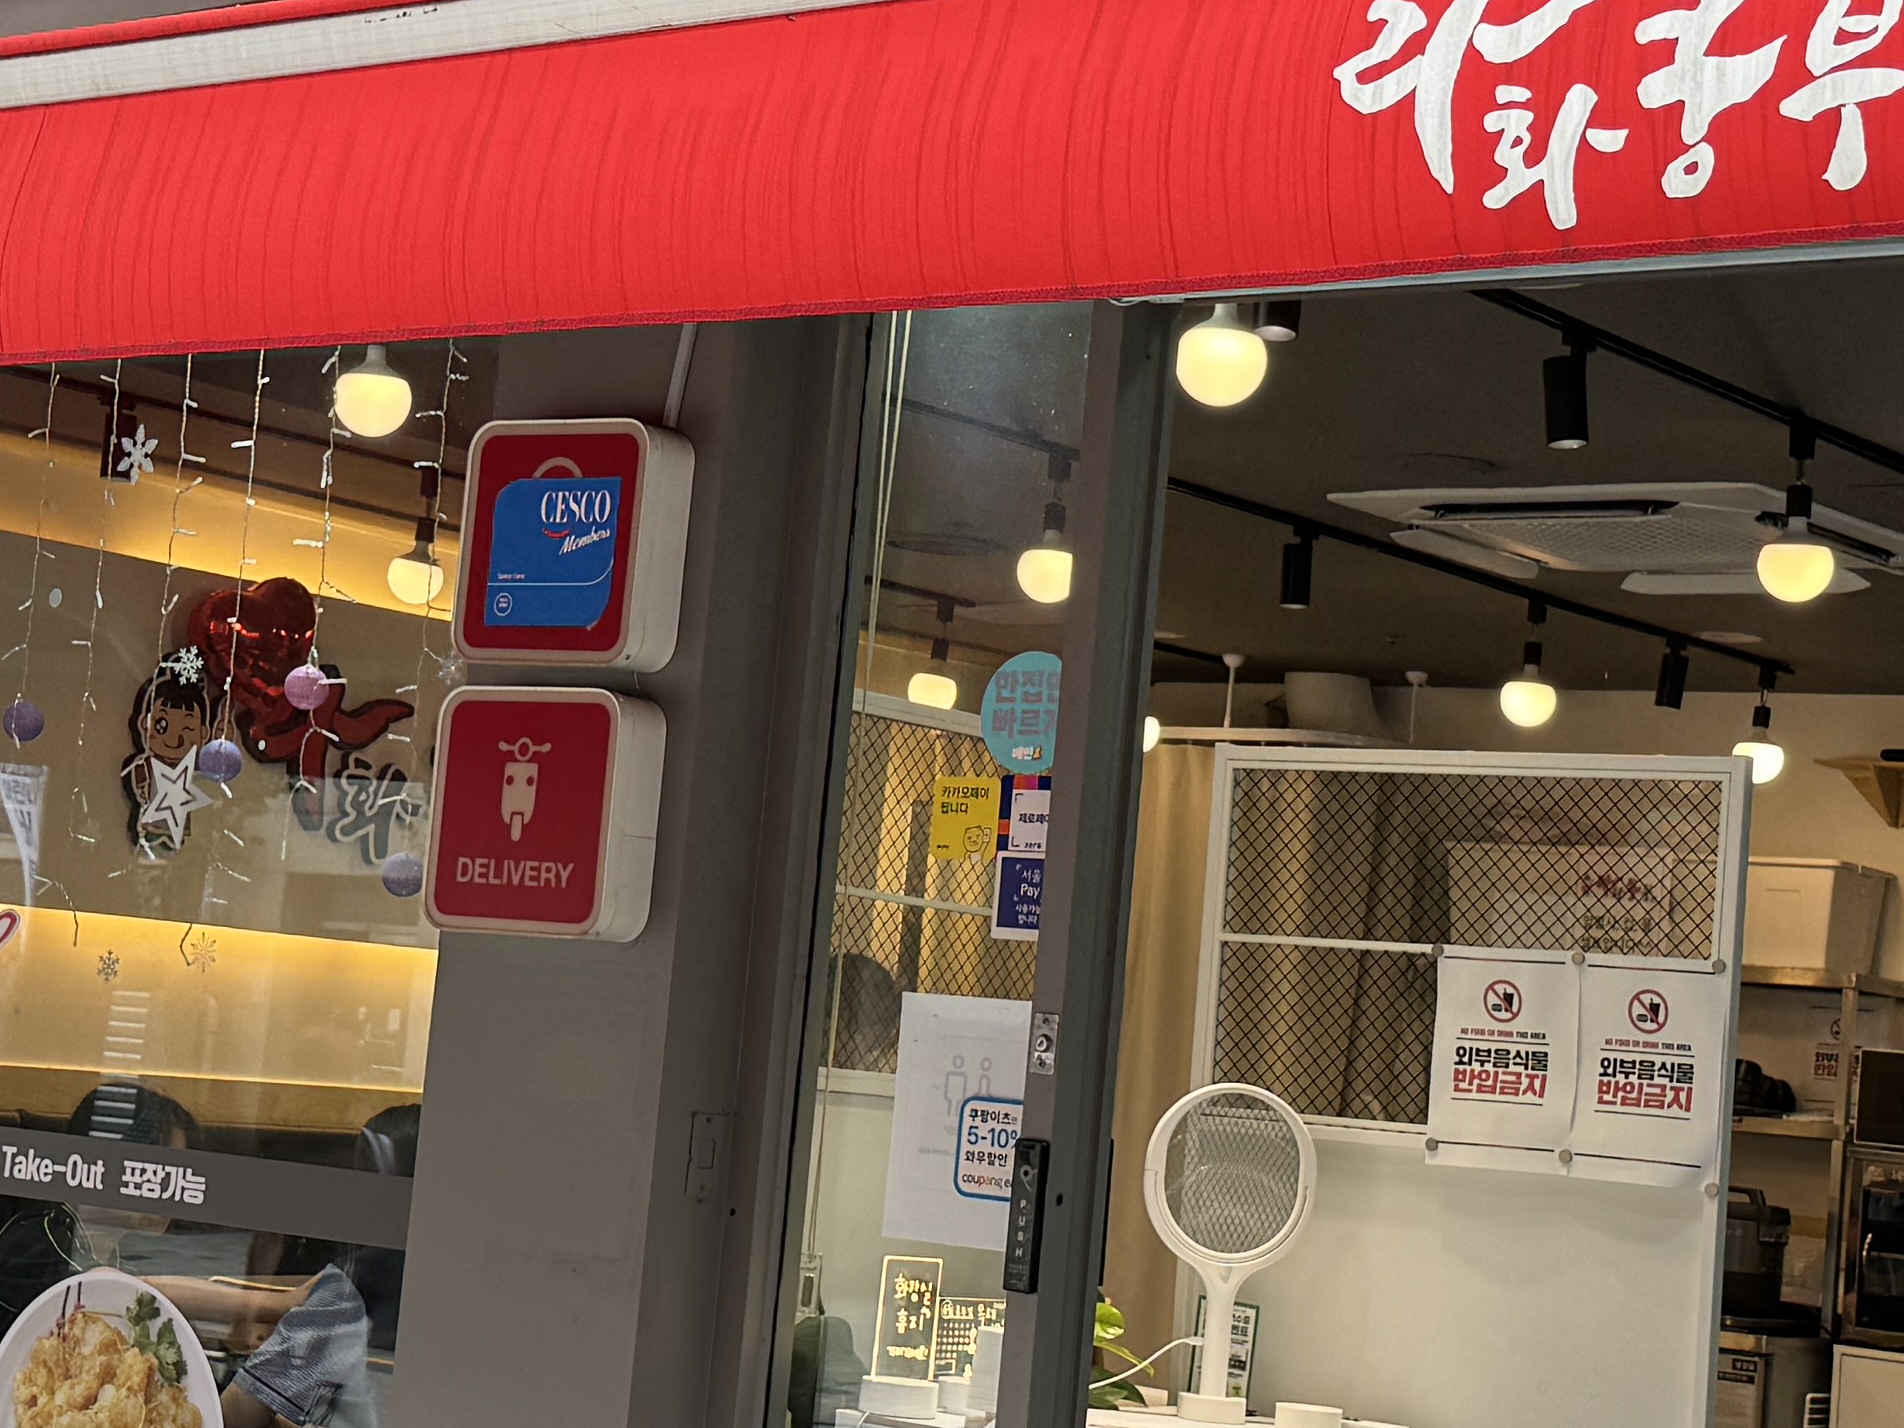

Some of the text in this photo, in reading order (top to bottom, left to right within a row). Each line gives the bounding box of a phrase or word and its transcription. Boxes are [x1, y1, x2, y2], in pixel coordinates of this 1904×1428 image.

[540, 490, 612, 525] CESCO
[558, 527, 611, 556] Members
[940, 785, 990, 800] 카카오페이
[456, 856, 574, 888] DELIVERY
[1021, 884, 1040, 899] Pay
[1454, 1046, 1549, 1072] 외부음식물
[1600, 1057, 1695, 1084] 외부음식물
[1453, 1069, 1548, 1099] 반입금지
[1597, 1080, 1693, 1113] 반입금지
[964, 1150, 1008, 1167] 와우할인
[2, 1145, 105, 1191] Take-Out
[119, 1158, 207, 1205] 포장가능
[962, 1173, 1003, 1189] coupang
